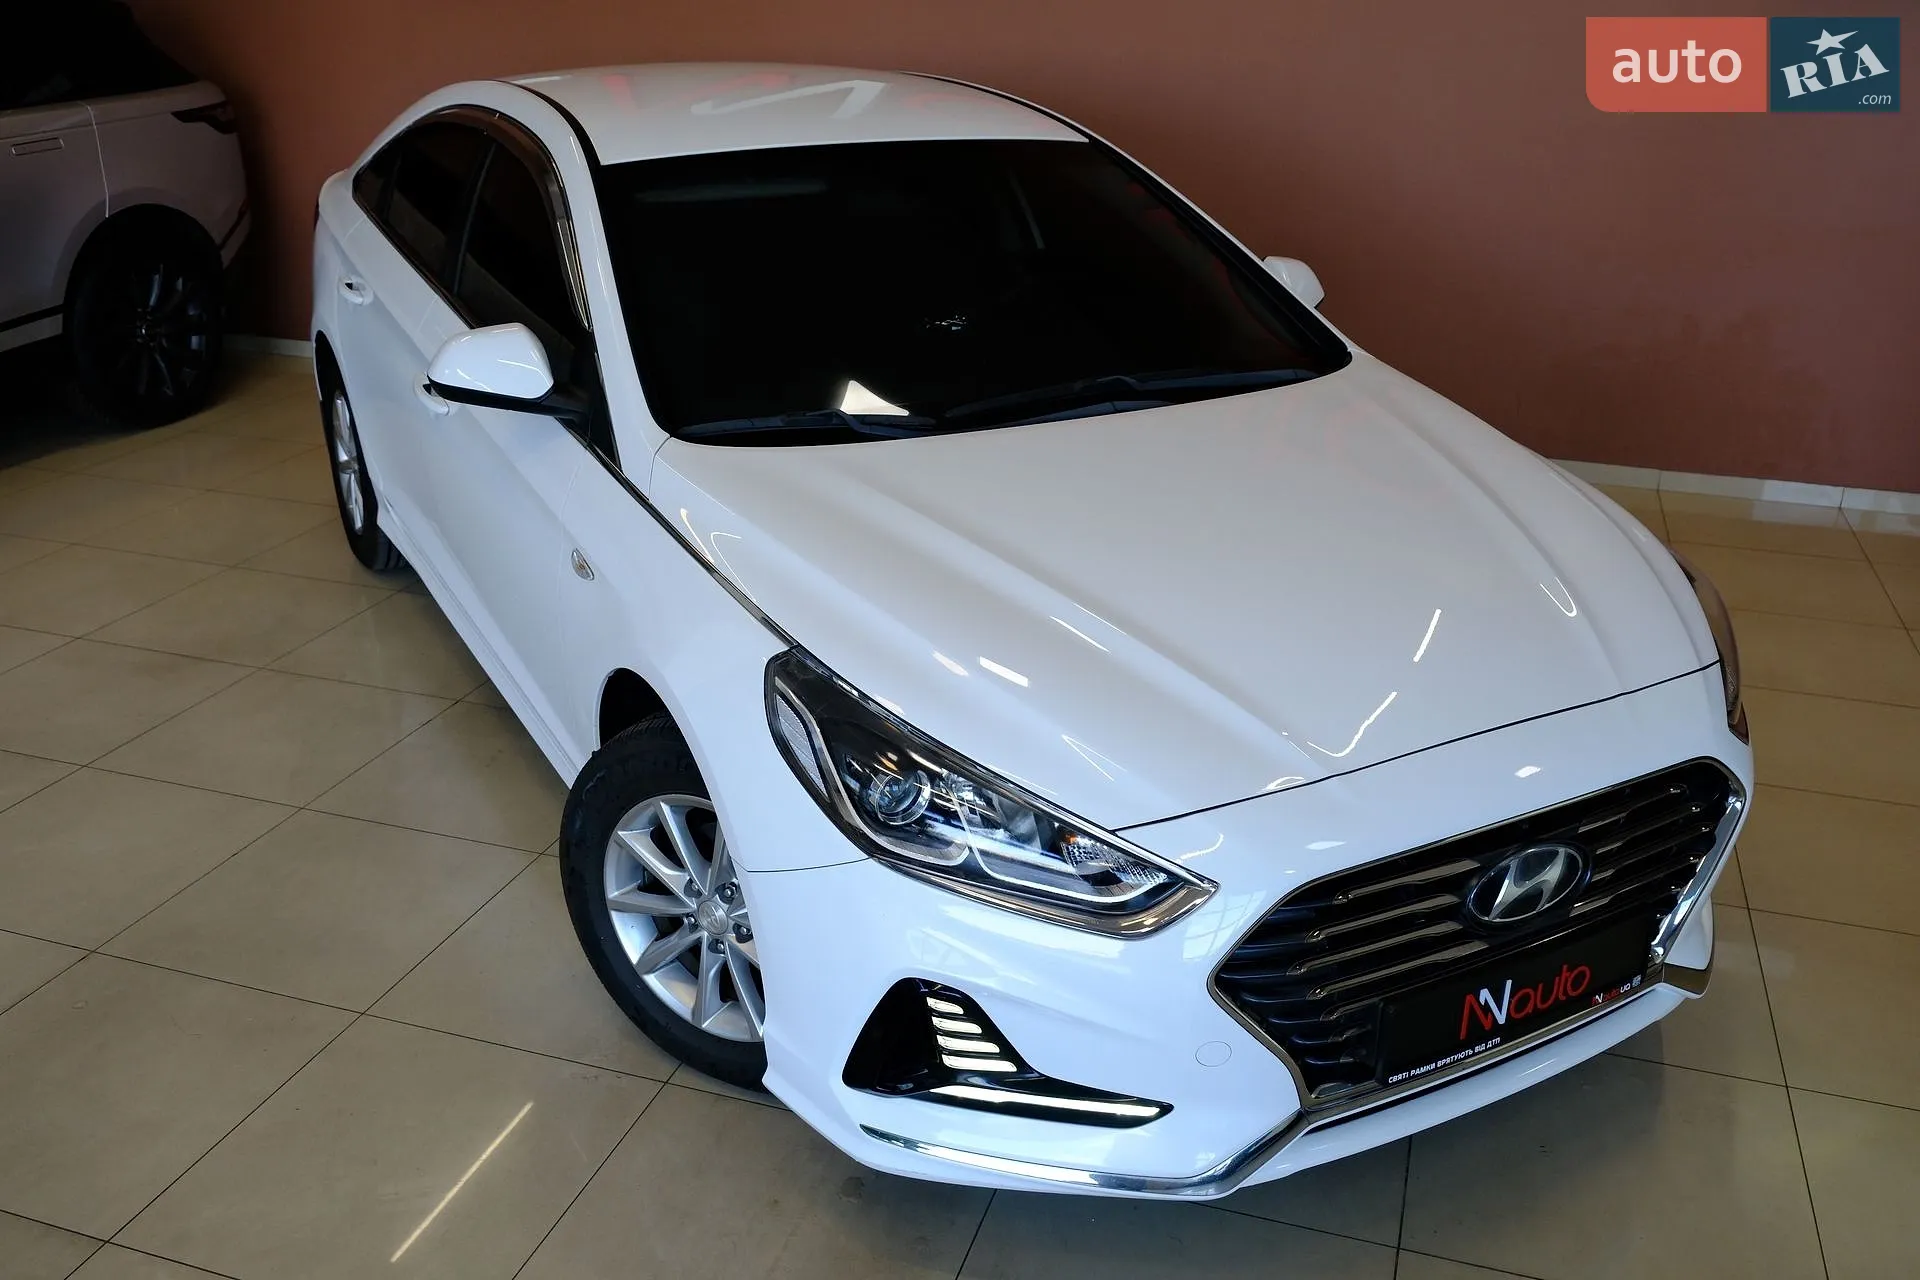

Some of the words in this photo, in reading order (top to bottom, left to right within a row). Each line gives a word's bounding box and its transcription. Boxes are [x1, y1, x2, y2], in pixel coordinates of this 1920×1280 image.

[1388, 1072, 1409, 1084] СВЯТІ
[1410, 1062, 1436, 1077] РАМКИ
[1437, 1048, 1474, 1068] ВРЯТУЮТЬ
